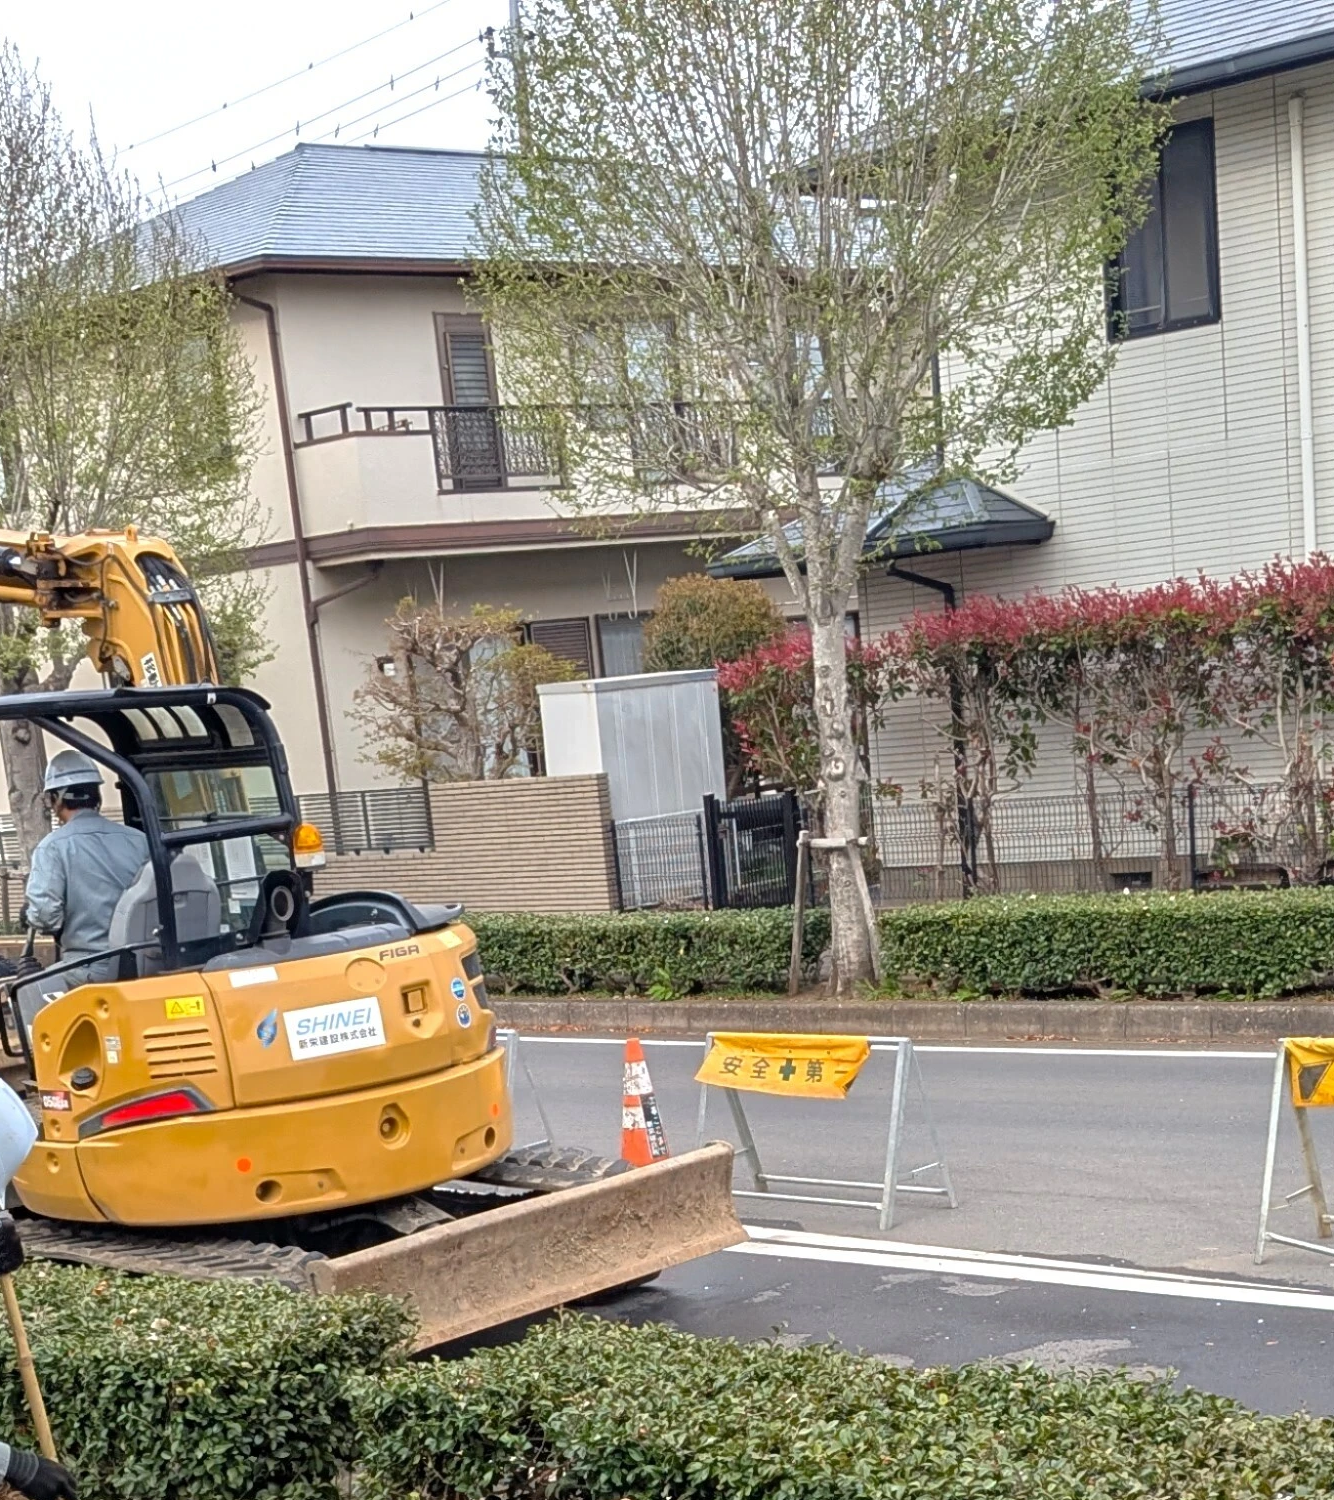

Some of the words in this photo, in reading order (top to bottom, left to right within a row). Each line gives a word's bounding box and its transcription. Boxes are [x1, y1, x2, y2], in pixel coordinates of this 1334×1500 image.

[378, 944, 420, 961] FIGA
[296, 1007, 372, 1036] SHINEI
[298, 1026, 377, 1050] 新栄建設株式会社
